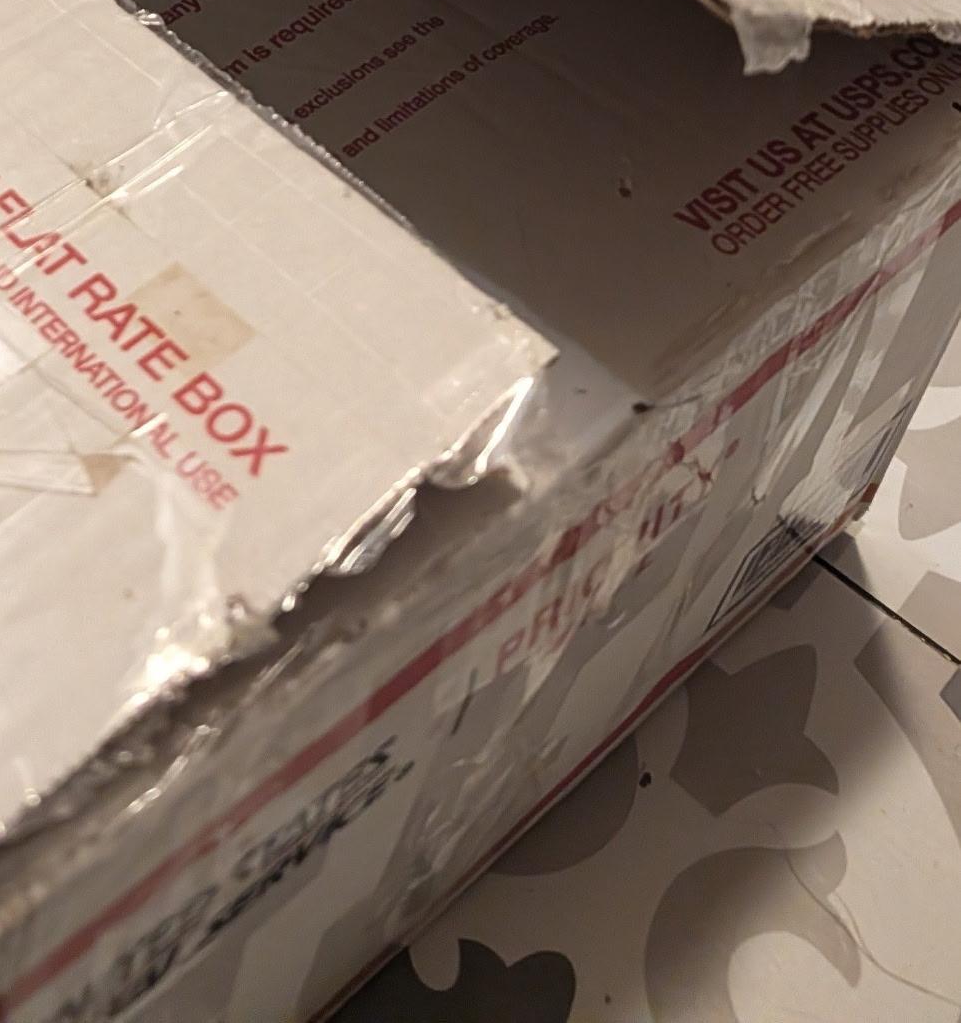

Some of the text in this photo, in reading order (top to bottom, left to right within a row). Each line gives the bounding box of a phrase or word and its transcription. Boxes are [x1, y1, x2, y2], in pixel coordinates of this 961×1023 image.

[242, 45, 272, 63] is
[293, 15, 445, 120] exclusions see the
[342, 13, 560, 159] and limitations of coverage.
[673, 167, 759, 232] VISIT
[745, 138, 803, 179] US
[790, 111, 836, 151] AT
[711, 191, 795, 256] ORDER
[780, 151, 845, 202] FREE
[831, 87, 929, 162] SUPPLIES
[8, 285, 180, 461] INTERNATIONAL
[174, 450, 239, 512] USE
[67, 272, 191, 383] RATE
[171, 370, 290, 478] BOX
